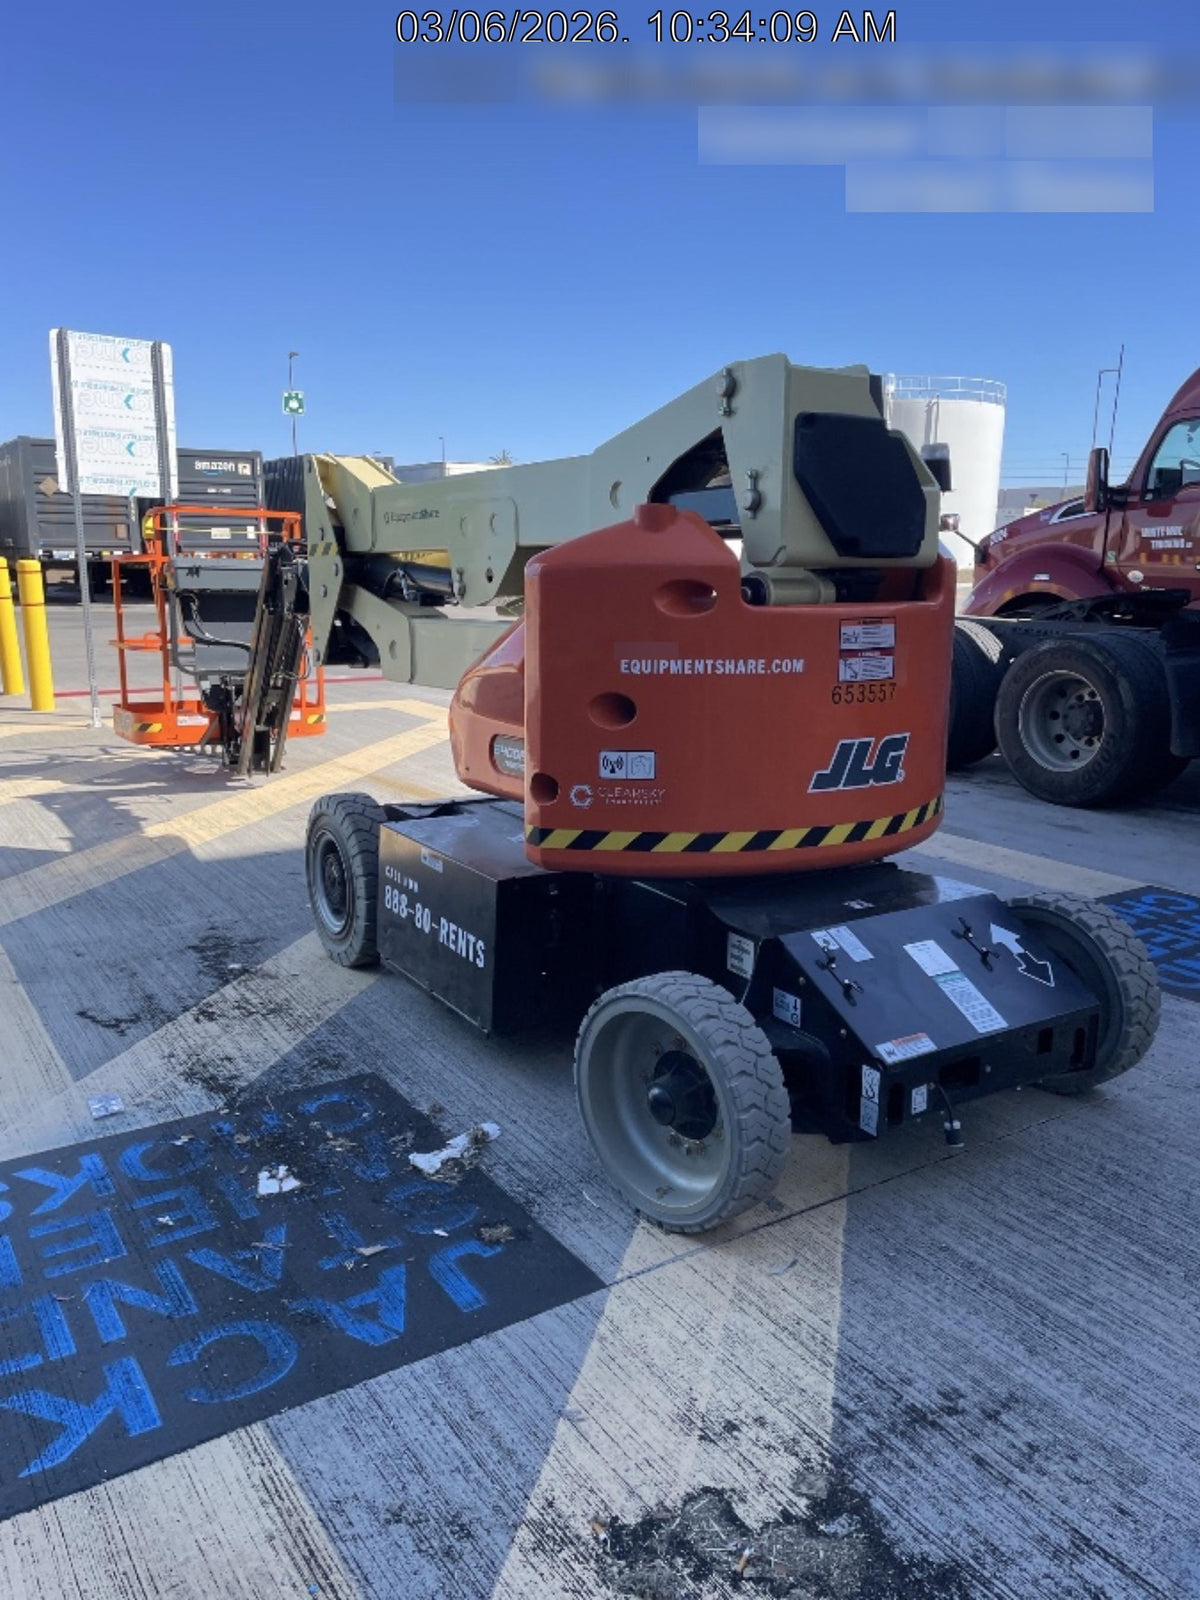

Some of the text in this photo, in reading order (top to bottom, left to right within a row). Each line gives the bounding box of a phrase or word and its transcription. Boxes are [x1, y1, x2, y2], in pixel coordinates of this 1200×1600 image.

[194, 460, 235, 471] amazon
[619, 658, 805, 675] EQUIPMENTSHARE.COM
[831, 683, 897, 705] 653557
[807, 732, 911, 793] JLG
[385, 885, 486, 968] 888-80-RENTS
[0, 1240, 502, 1477] JACK
